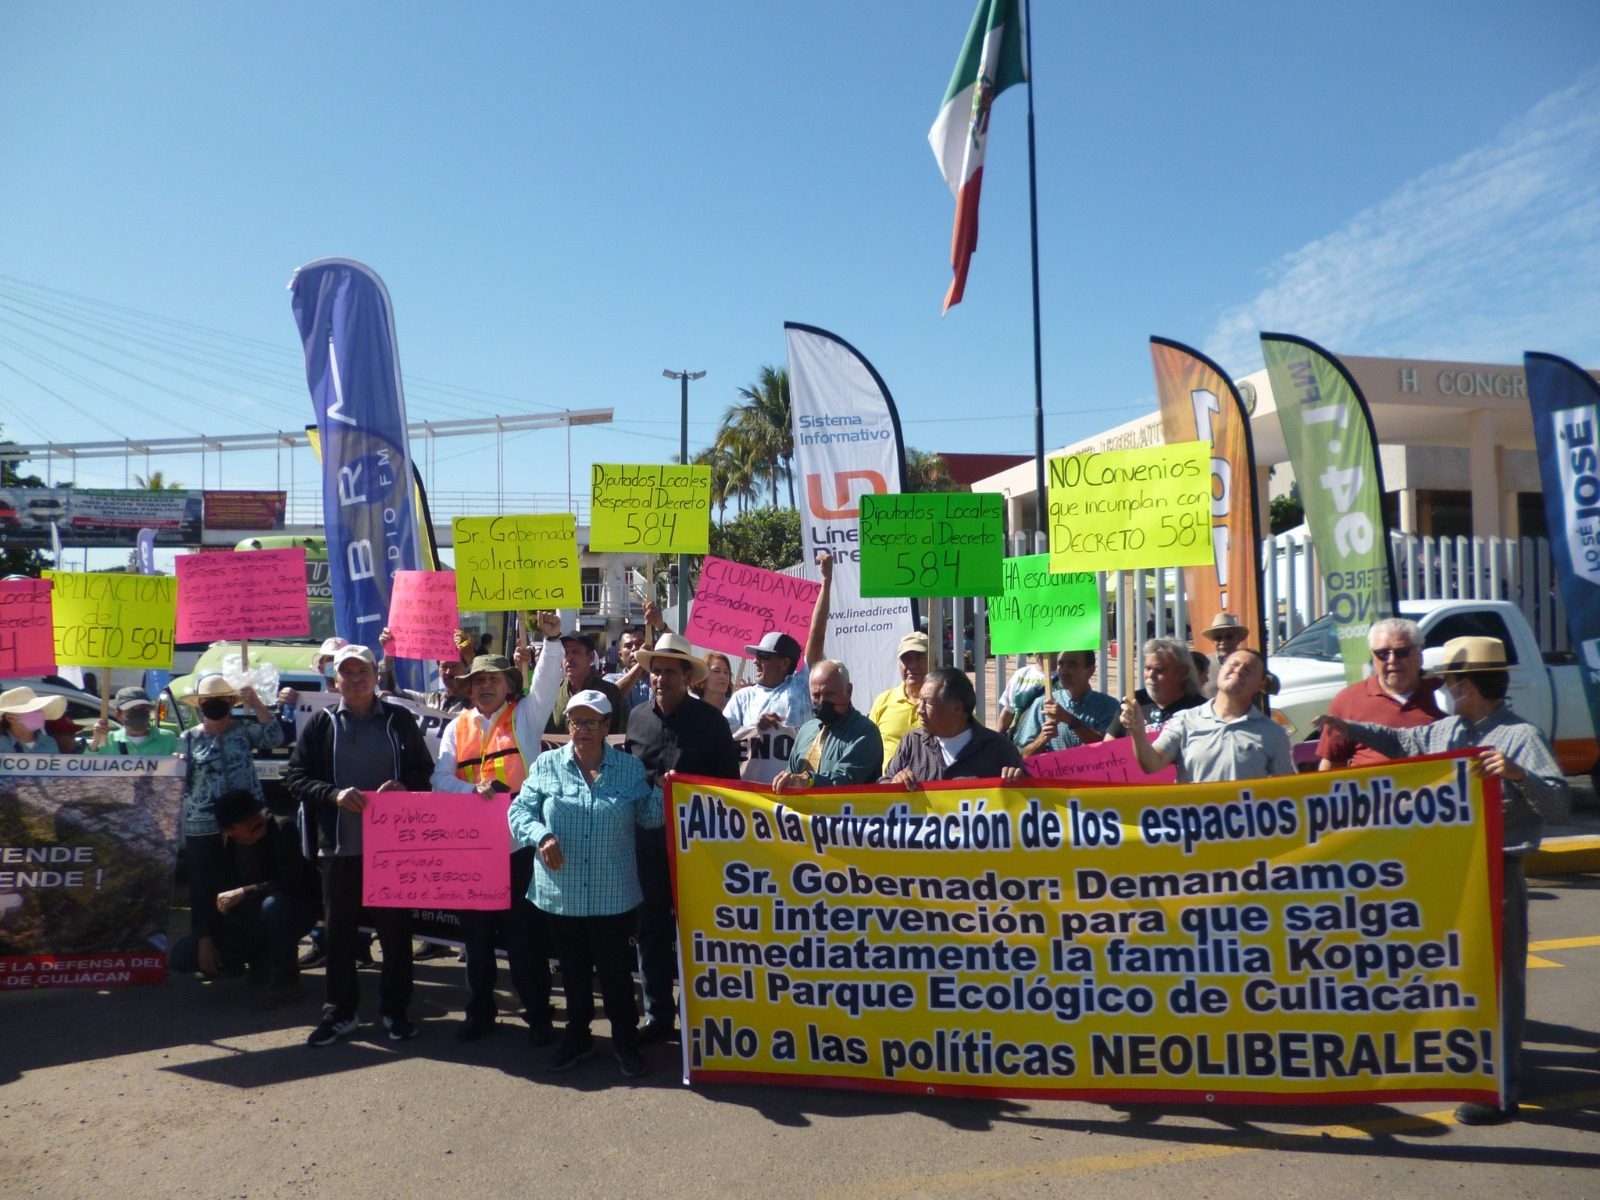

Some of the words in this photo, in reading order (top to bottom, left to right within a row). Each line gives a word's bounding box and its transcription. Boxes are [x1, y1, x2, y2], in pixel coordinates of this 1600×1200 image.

[1401, 367, 1420, 394] H
[1437, 370, 1528, 398] CONGR
[799, 413, 862, 428] Sistema
[800, 428, 890, 446] Informativo
[376, 448, 393, 486] FM
[592, 464, 656, 491] Diputados
[658, 466, 708, 489] Locales
[1050, 456, 1081, 490] NO
[1083, 452, 1201, 487] Convenios
[592, 487, 640, 513] Respeto
[655, 488, 706, 510] Decreto
[861, 494, 934, 525] Diputados
[945, 496, 1000, 520] Locales
[1050, 501, 1079, 524] que
[1085, 490, 1168, 520] incumplan
[1176, 491, 1211, 506] con
[455, 517, 484, 544] Sr.
[489, 516, 575, 543] Gobernador
[623, 512, 677, 547] 584
[812, 527, 858, 545] Líne
[862, 520, 917, 552] Respeto
[921, 529, 935, 545] al
[940, 521, 996, 546] Decreto
[1157, 509, 1212, 549] 584
[813, 548, 860, 566] Dire
[895, 550, 961, 589] 584
[2, 582, 50, 605] ocales
[469, 572, 565, 601] Audiencia
[704, 560, 821, 605] CIUDADANOS
[82, 602, 122, 627] del
[696, 584, 774, 618] defendamos
[784, 608, 809, 627] los
[1024, 603, 1085, 630] apoyanos
[693, 606, 753, 641] Espacios
[835, 621, 893, 637] portal.com
[53, 625, 124, 658] ECRETO
[128, 627, 174, 662] 584
[36, 759, 60, 771] DE
[66, 756, 159, 772] CULIACÁN
[678, 793, 746, 850] ¡Alto
[752, 810, 772, 840] a
[776, 803, 804, 843] la
[810, 799, 1011, 854] privatización
[1020, 800, 1061, 848] de
[1069, 799, 1122, 847] los
[1140, 790, 1298, 854] espacios
[1306, 760, 1471, 844] públicos!
[398, 828, 416, 842] ES
[422, 828, 480, 841] SERVICIO
[399, 872, 417, 884] ES
[423, 871, 482, 883] NEGOCIO
[724, 862, 778, 895] Sr.
[792, 862, 1061, 901] Gobernador:
[1076, 859, 1405, 900] Demandamos
[715, 905, 760, 931] su
[774, 899, 1046, 934] intervención
[1061, 909, 1165, 942] para
[1181, 905, 1270, 946] que
[1285, 896, 1421, 938] salga
[12, 961, 35, 972] LA
[41, 958, 126, 972] DEFENSA
[131, 957, 163, 969] DEL
[693, 931, 1038, 972] inmediatamente
[1052, 938, 1093, 972] la
[1106, 938, 1272, 973] familia
[1287, 932, 1461, 979] Koppel
[7, 975, 32, 986] DE
[694, 968, 754, 1000] del
[766, 972, 915, 1017] Parque
[929, 976, 1154, 1021] Ecológico
[1168, 978, 1229, 1015] de
[1243, 974, 1477, 1013] Culiacán.
[691, 1017, 759, 1068] ¡No
[771, 1029, 797, 1061] a
[807, 1023, 869, 1065] las
[881, 1029, 1077, 1078] políticas
[1091, 1028, 1495, 1079] NEOLIBERALES!
